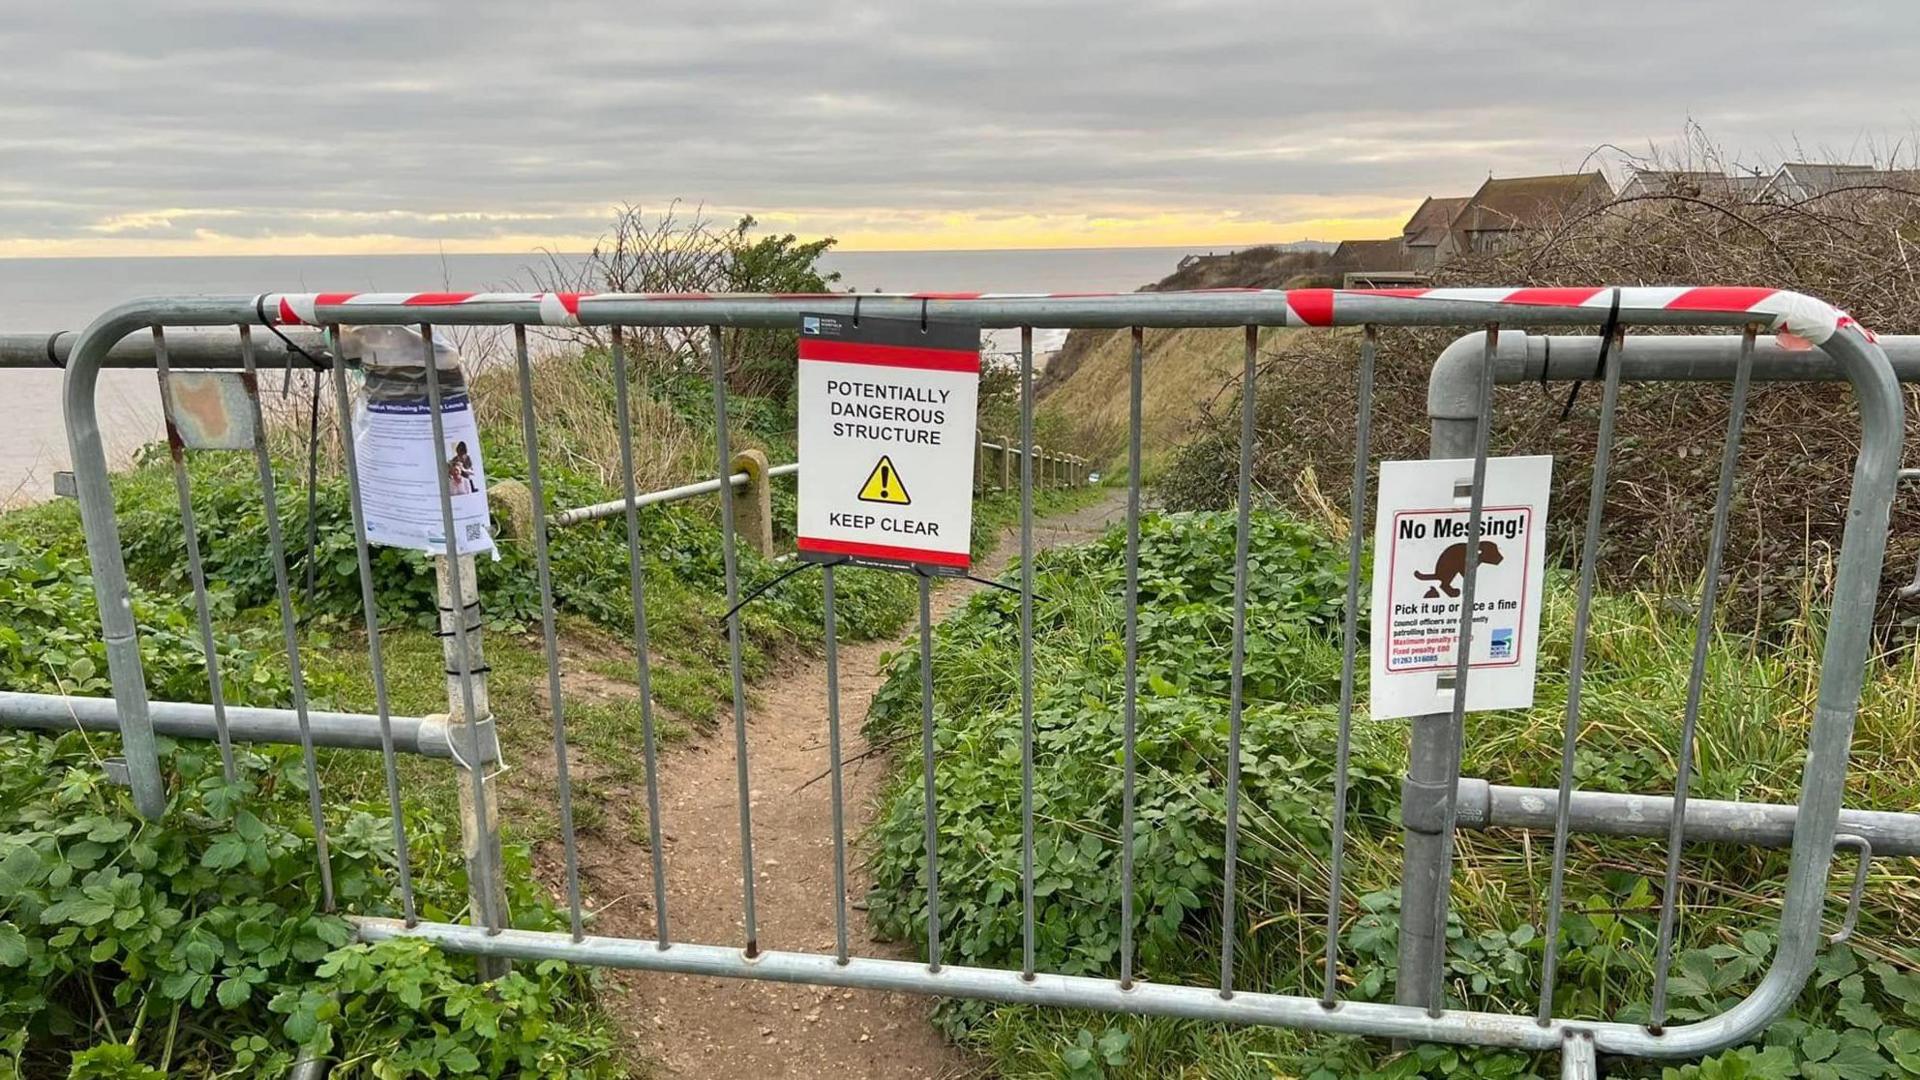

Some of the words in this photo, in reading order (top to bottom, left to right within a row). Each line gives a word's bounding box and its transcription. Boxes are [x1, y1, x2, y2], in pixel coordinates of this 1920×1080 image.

[827, 380, 950, 404] POTENTIALLY
[831, 402, 945, 425] DANGEROUS
[833, 423, 941, 445] STRUCTURE
[830, 512, 875, 529] KEEP
[880, 517, 939, 536] CLEAR
[1400, 519, 1426, 539] No
[1395, 604, 1418, 615] Pick
[1421, 603, 1429, 613] it
[1432, 604, 1445, 615] up
[1448, 603, 1460, 612] or
[1488, 601, 1494, 610] a
[1498, 599, 1517, 609] fine
[1394, 619, 1417, 627] Council
[1419, 618, 1445, 626] officers
[1393, 629, 1425, 638] patrolling
[1393, 638, 1425, 646] Maximum
[1427, 636, 1451, 644] penalty
[1411, 646, 1435, 655] penalty
